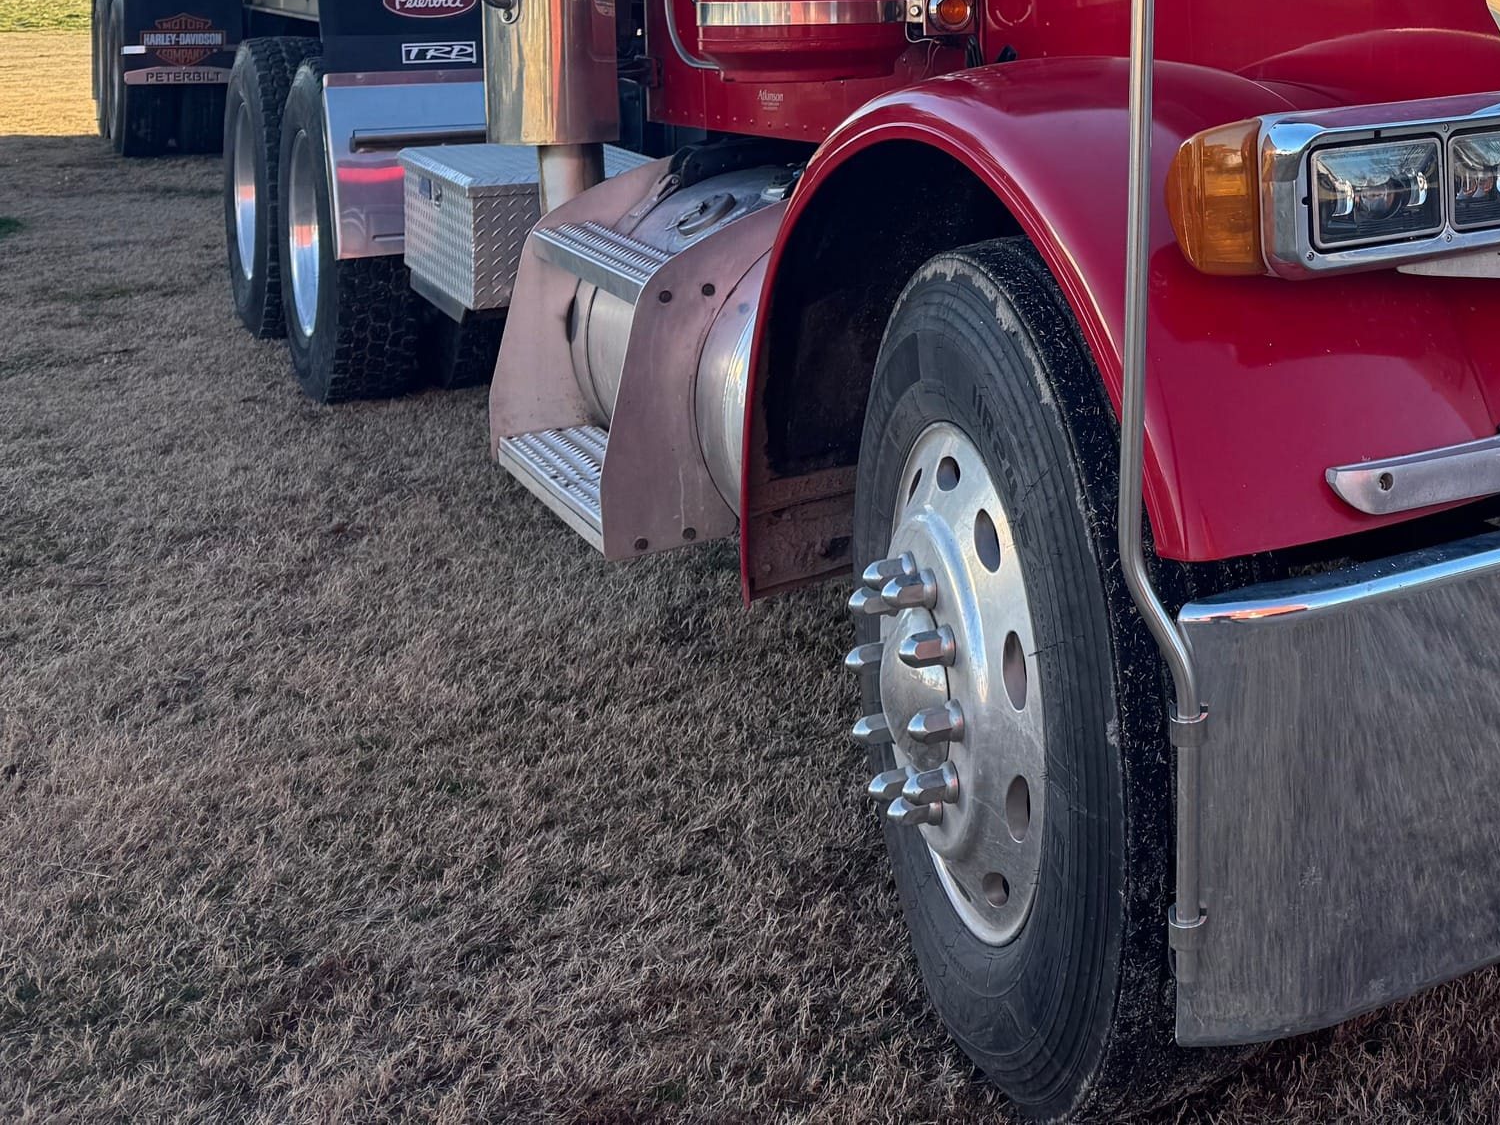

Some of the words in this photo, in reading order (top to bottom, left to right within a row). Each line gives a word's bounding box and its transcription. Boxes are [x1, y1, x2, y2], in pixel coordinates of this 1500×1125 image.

[162, 18, 206, 30] MOTOR
[143, 33, 222, 46] HARLEY-DAVIDSON
[161, 48, 204, 64] COMPANY
[404, 44, 474, 60] TRP
[145, 71, 222, 83] PETERBILT
